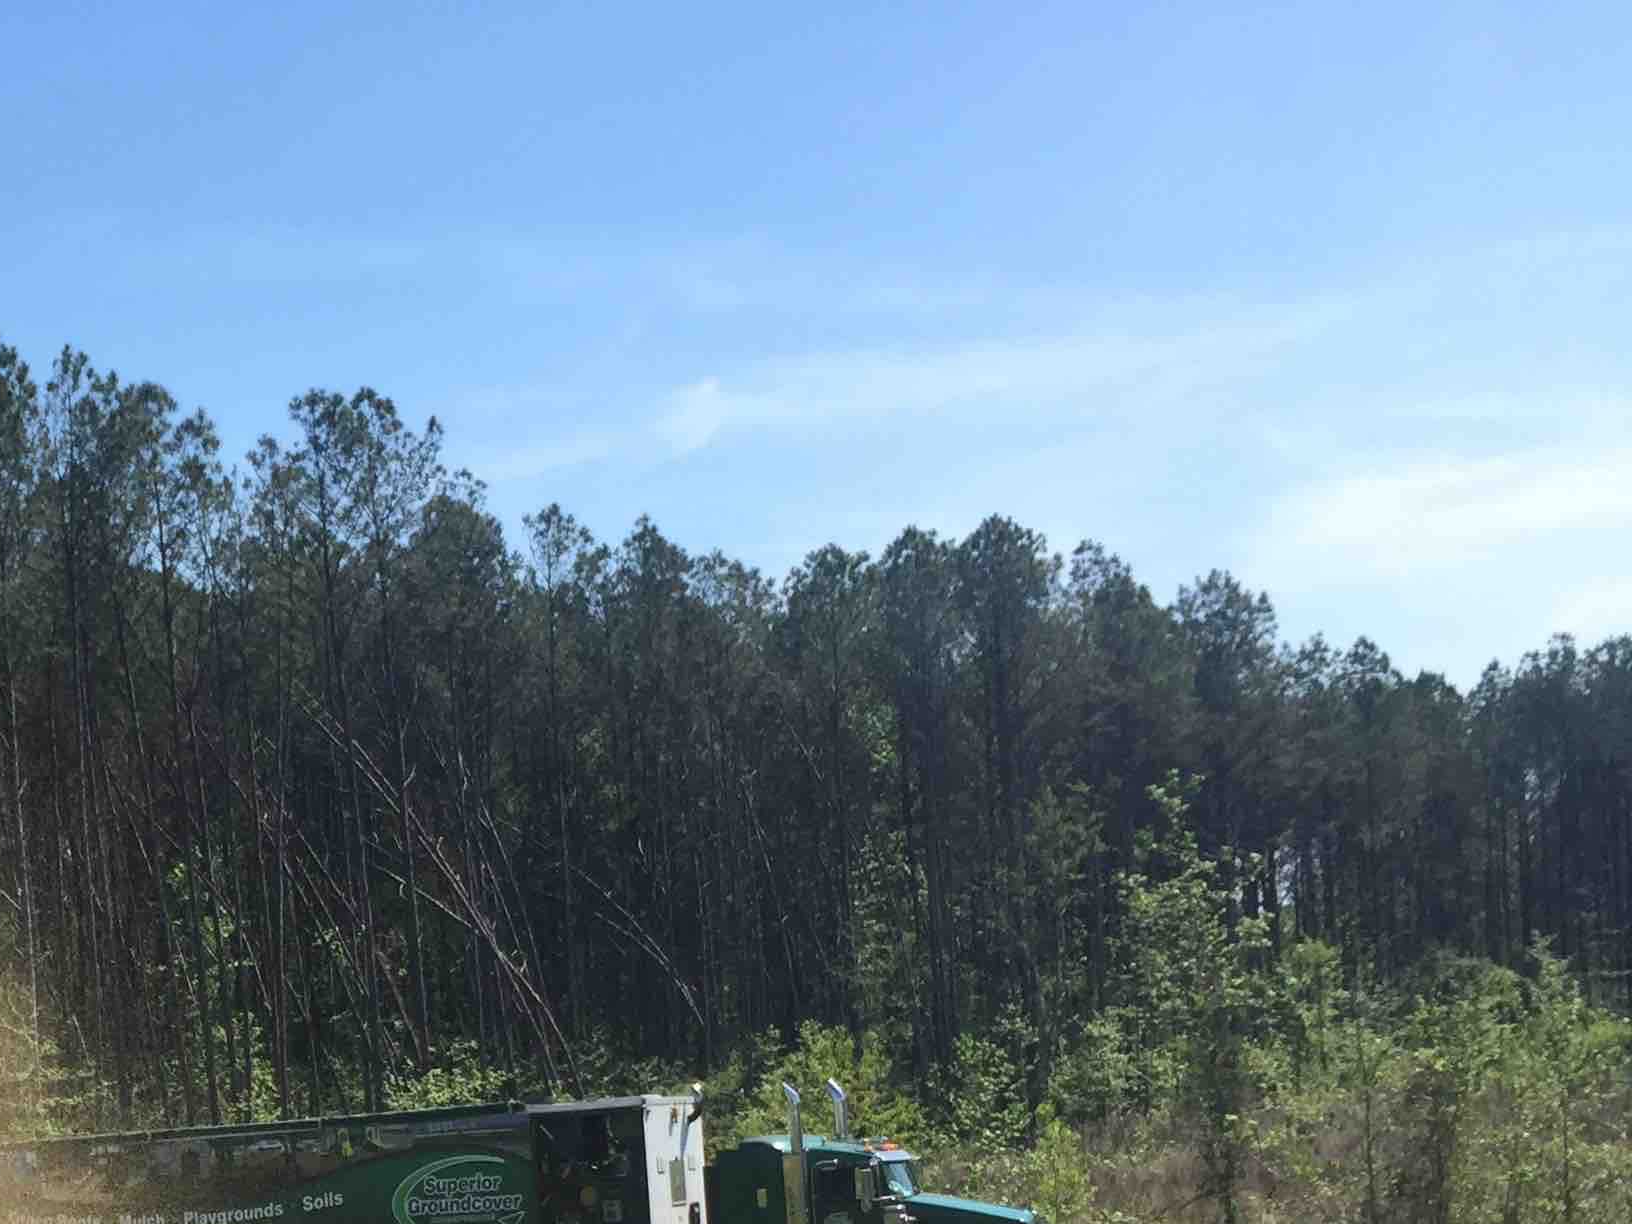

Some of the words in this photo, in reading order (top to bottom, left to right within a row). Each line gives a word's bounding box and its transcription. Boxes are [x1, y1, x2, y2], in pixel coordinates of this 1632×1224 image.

[424, 1172, 503, 1195] Superior
[302, 1191, 344, 1212] Soils
[408, 1194, 522, 1215] Groundcover
